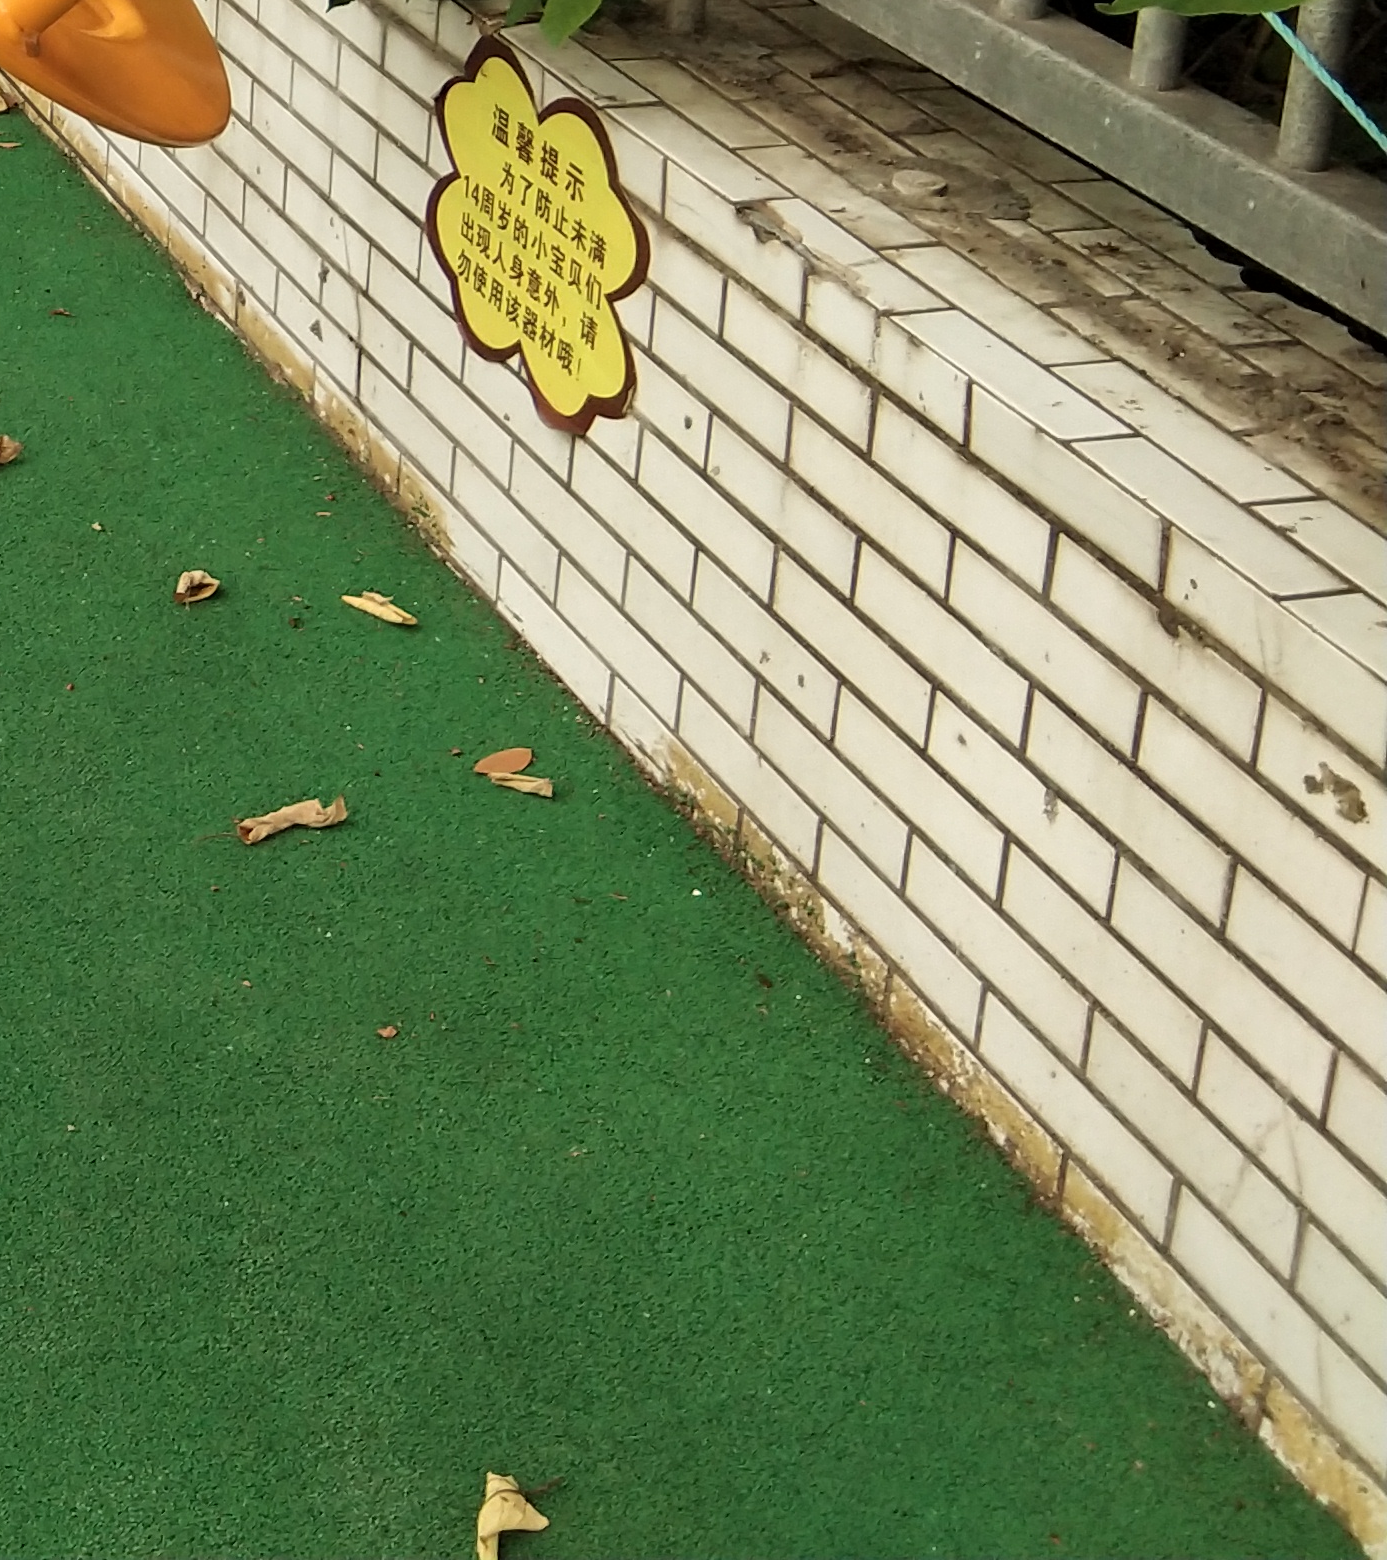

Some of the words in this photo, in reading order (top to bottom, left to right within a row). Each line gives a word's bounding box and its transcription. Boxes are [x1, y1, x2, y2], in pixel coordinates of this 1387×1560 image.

[492, 104, 585, 202] 温馨提示
[464, 175, 602, 310] 14周岁的小宝贝们
[500, 161, 606, 269] 为了防止未满
